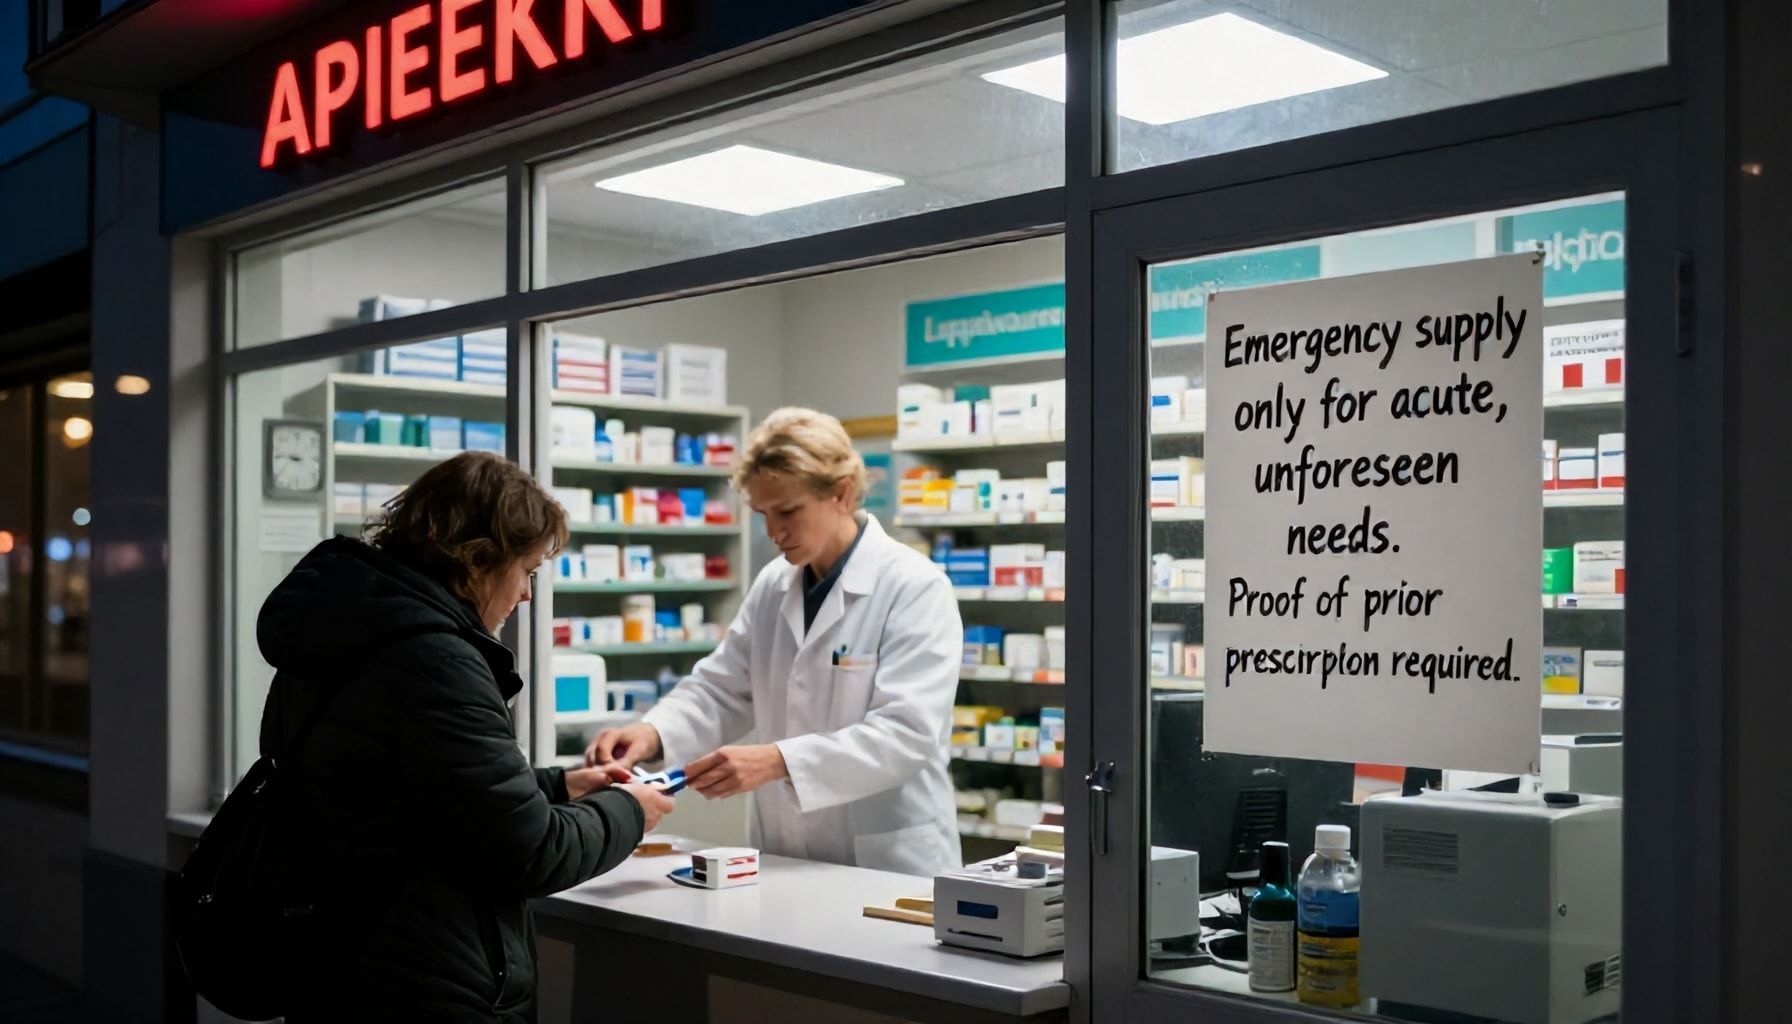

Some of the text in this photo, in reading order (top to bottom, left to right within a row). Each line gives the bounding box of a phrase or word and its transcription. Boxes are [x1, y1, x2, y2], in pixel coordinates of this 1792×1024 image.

[1224, 295, 1528, 375] Emergency supply
[1234, 372, 1508, 445] only for acute,
[1254, 444, 1459, 506] unforeseen
[1287, 505, 1401, 556] needs.
[1228, 574, 1444, 633] Proof of prior
[1391, 637, 1521, 695] required.
